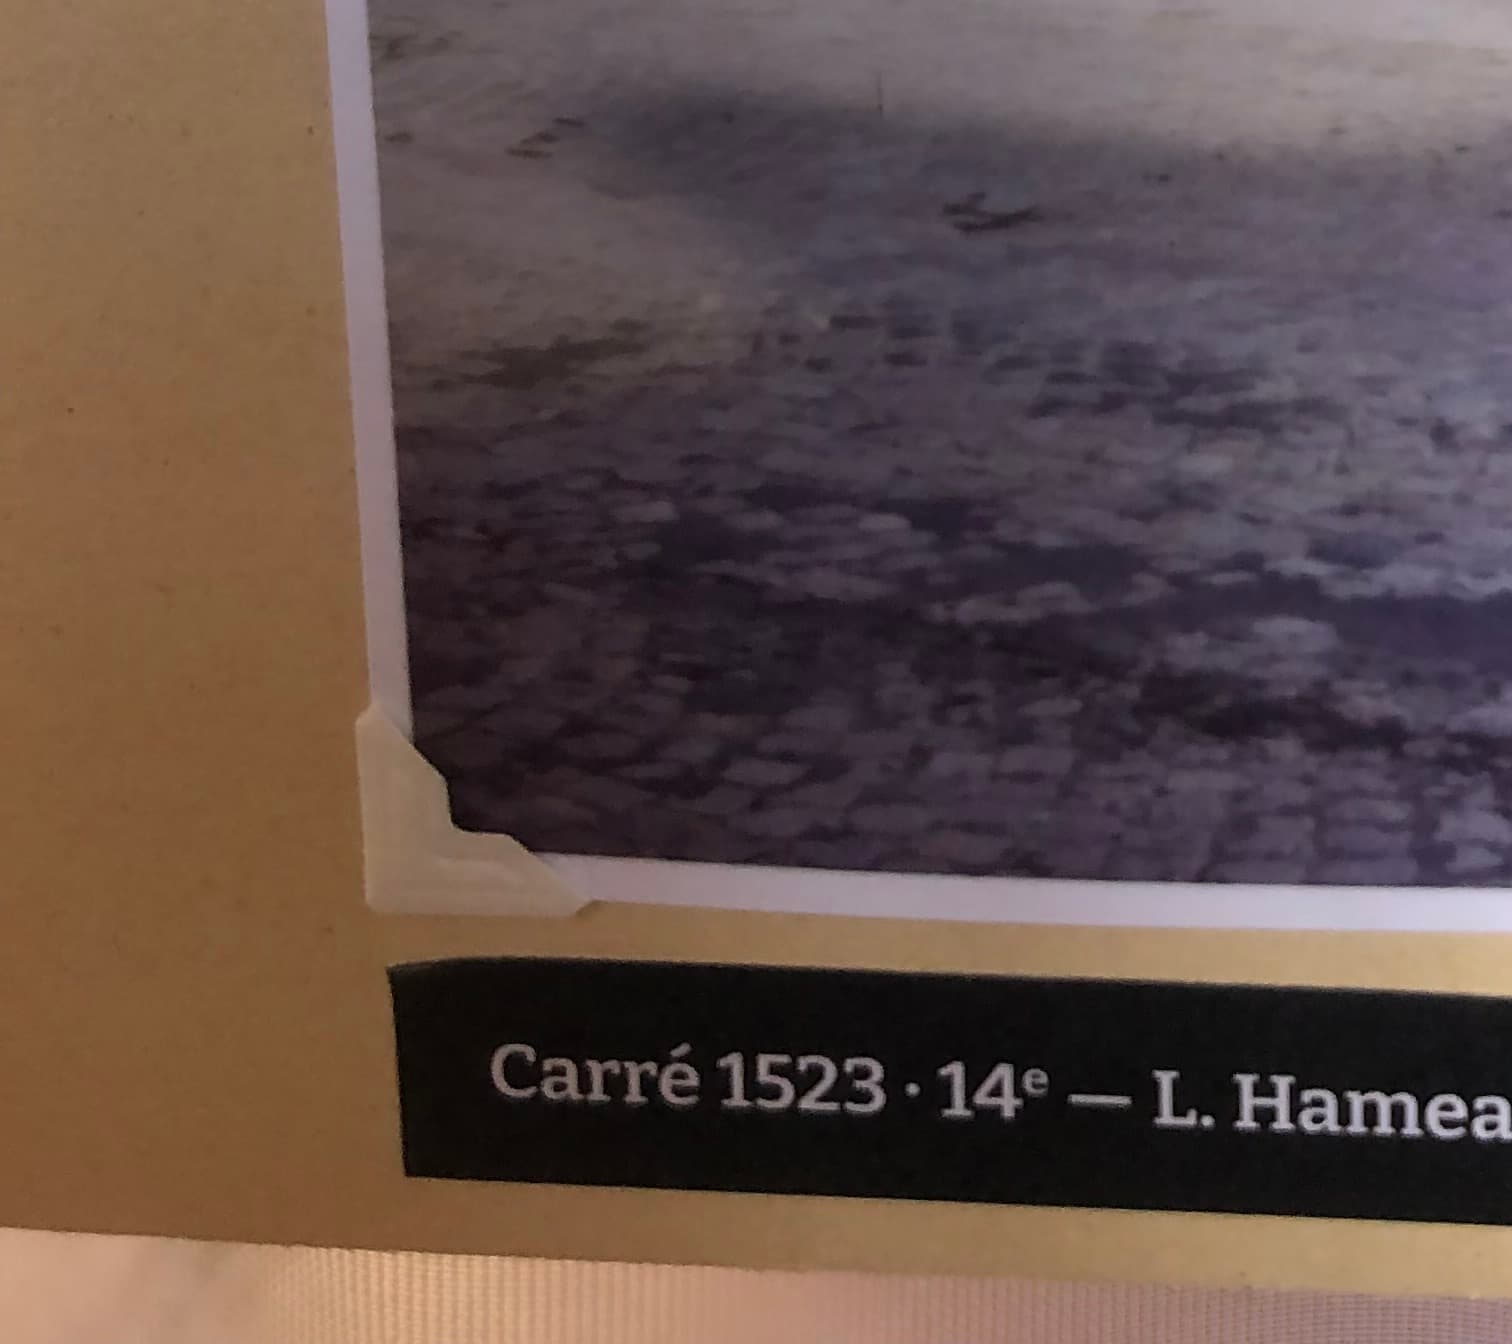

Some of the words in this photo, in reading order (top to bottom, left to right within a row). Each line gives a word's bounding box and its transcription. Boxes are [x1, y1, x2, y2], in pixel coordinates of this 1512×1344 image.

[490, 1043, 699, 1106] Carré
[716, 1051, 887, 1113] 1523
[1152, 1069, 1215, 1129] L.
